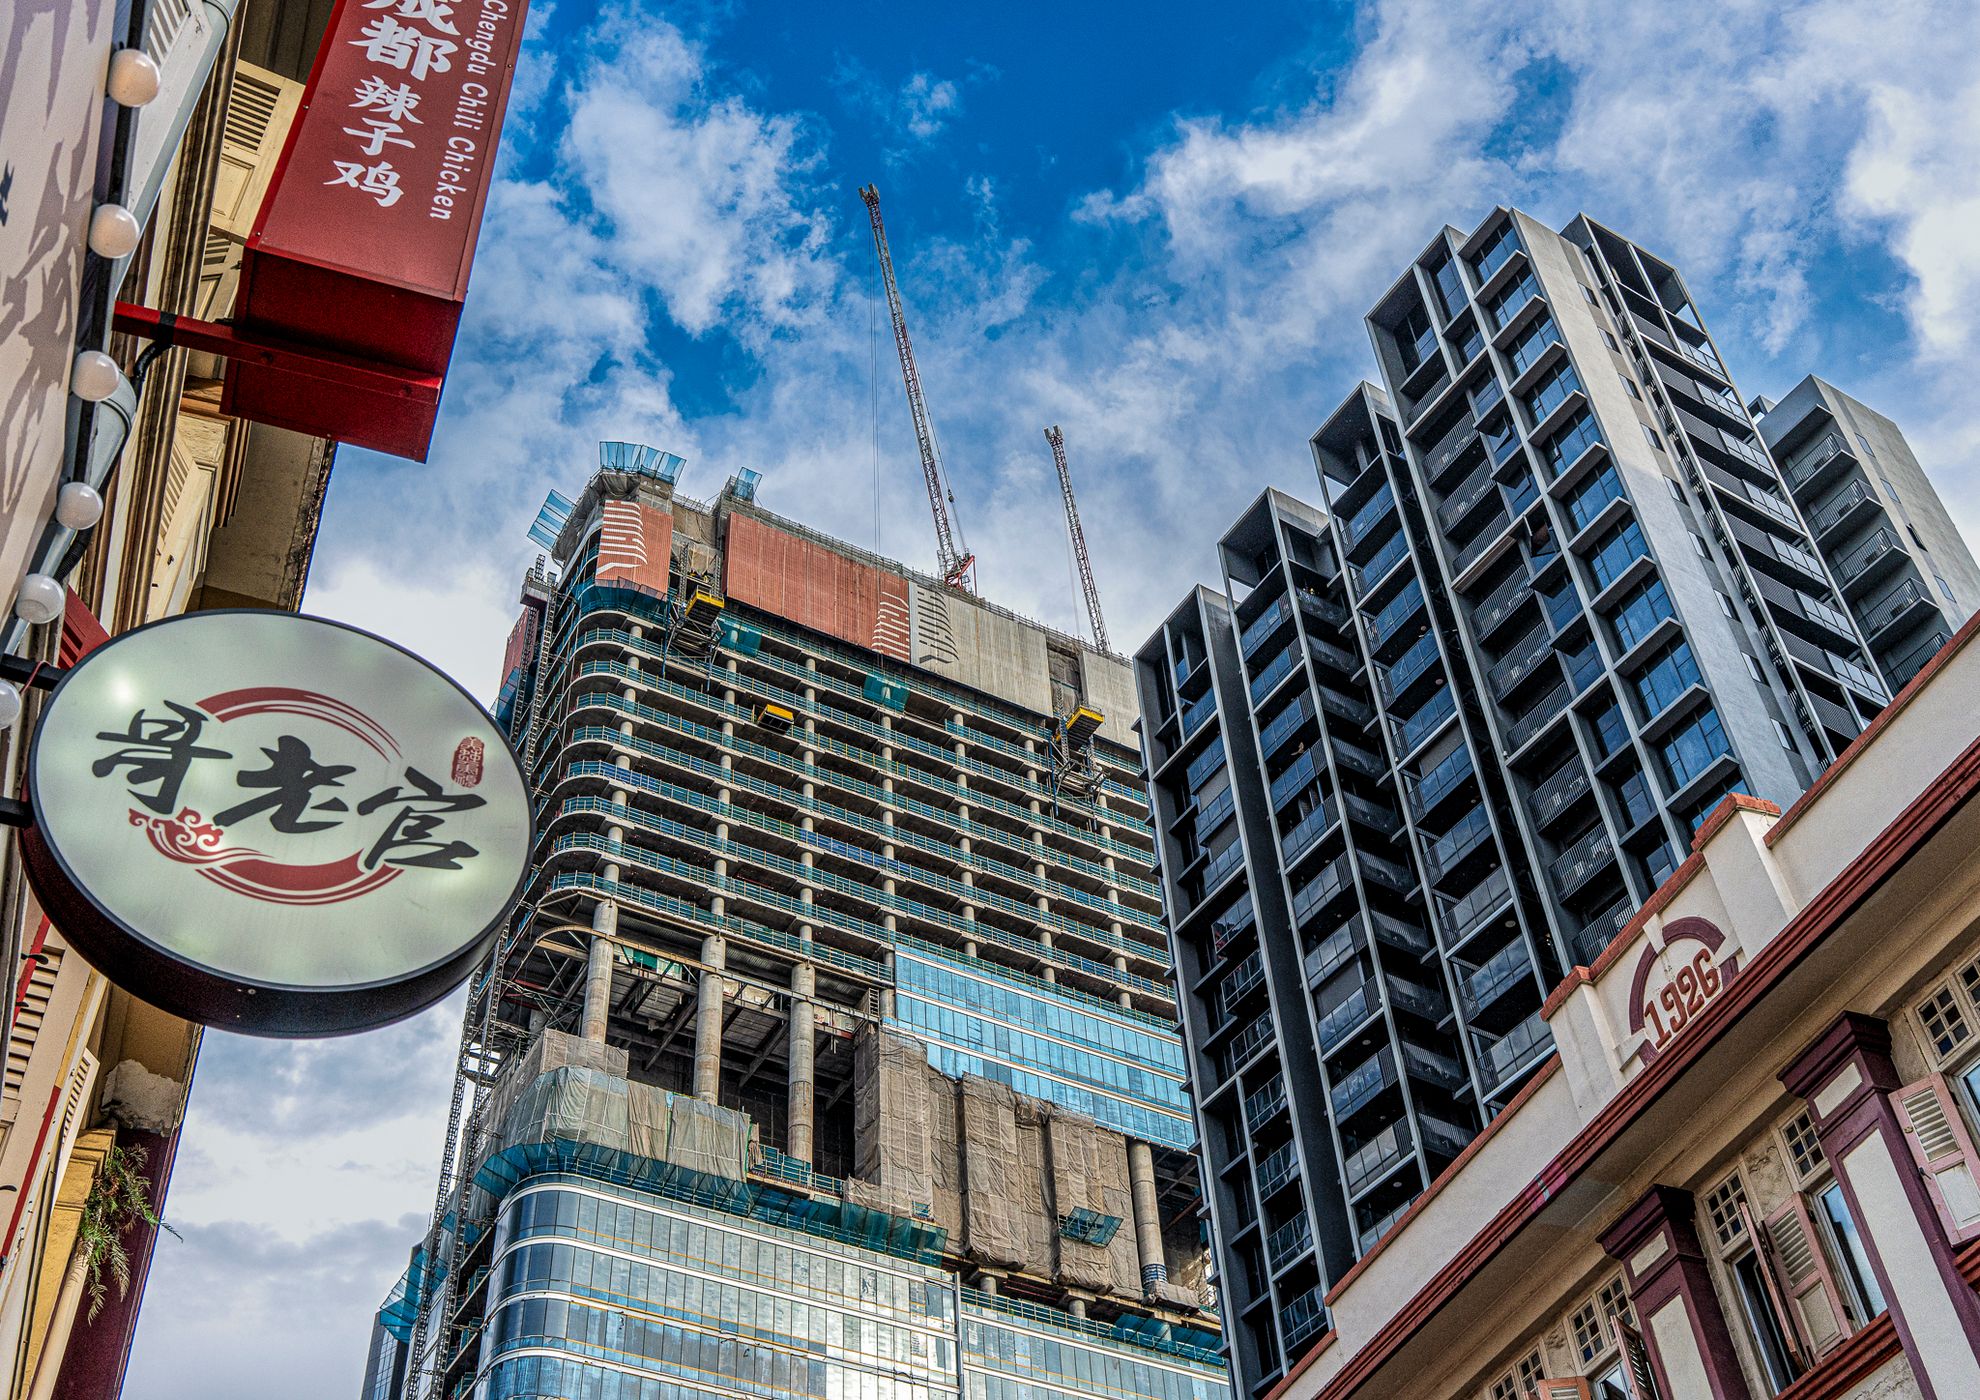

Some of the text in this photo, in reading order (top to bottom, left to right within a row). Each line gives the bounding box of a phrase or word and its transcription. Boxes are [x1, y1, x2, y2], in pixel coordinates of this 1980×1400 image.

[429, 0, 508, 220] Chengdu Chili Chicken
[1644, 948, 1719, 1049] 1926
